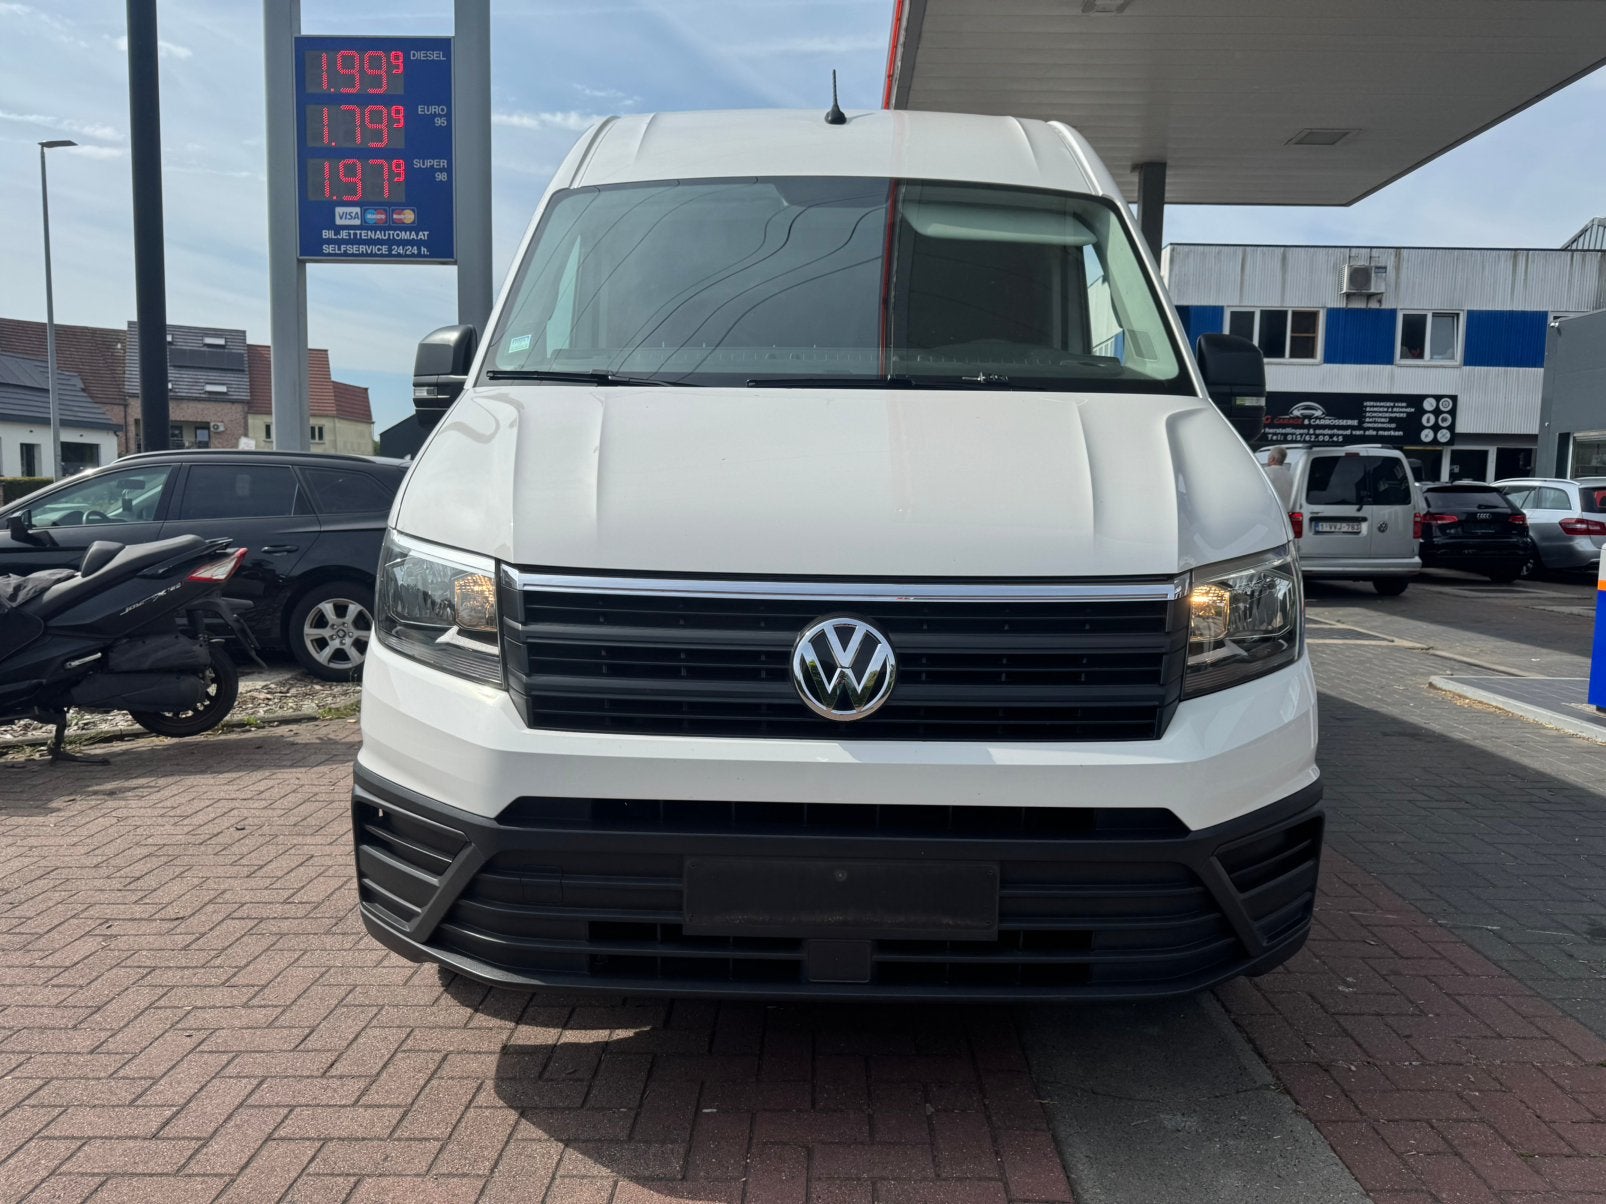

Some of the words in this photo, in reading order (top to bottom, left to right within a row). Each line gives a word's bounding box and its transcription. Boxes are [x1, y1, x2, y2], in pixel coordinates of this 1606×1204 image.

[410, 51, 447, 61] DIESEL
[417, 105, 447, 115] EURO
[434, 117, 447, 127] 95
[413, 159, 448, 169] SUPER
[435, 172, 448, 182] 98
[338, 211, 360, 221] VISA
[322, 229, 429, 240] BILJETTENAUTOMAAT
[322, 244, 389, 255] SELFSERVICE
[391, 245, 418, 256] 24/24
[1310, 418, 1359, 426] CARROSSERIE
